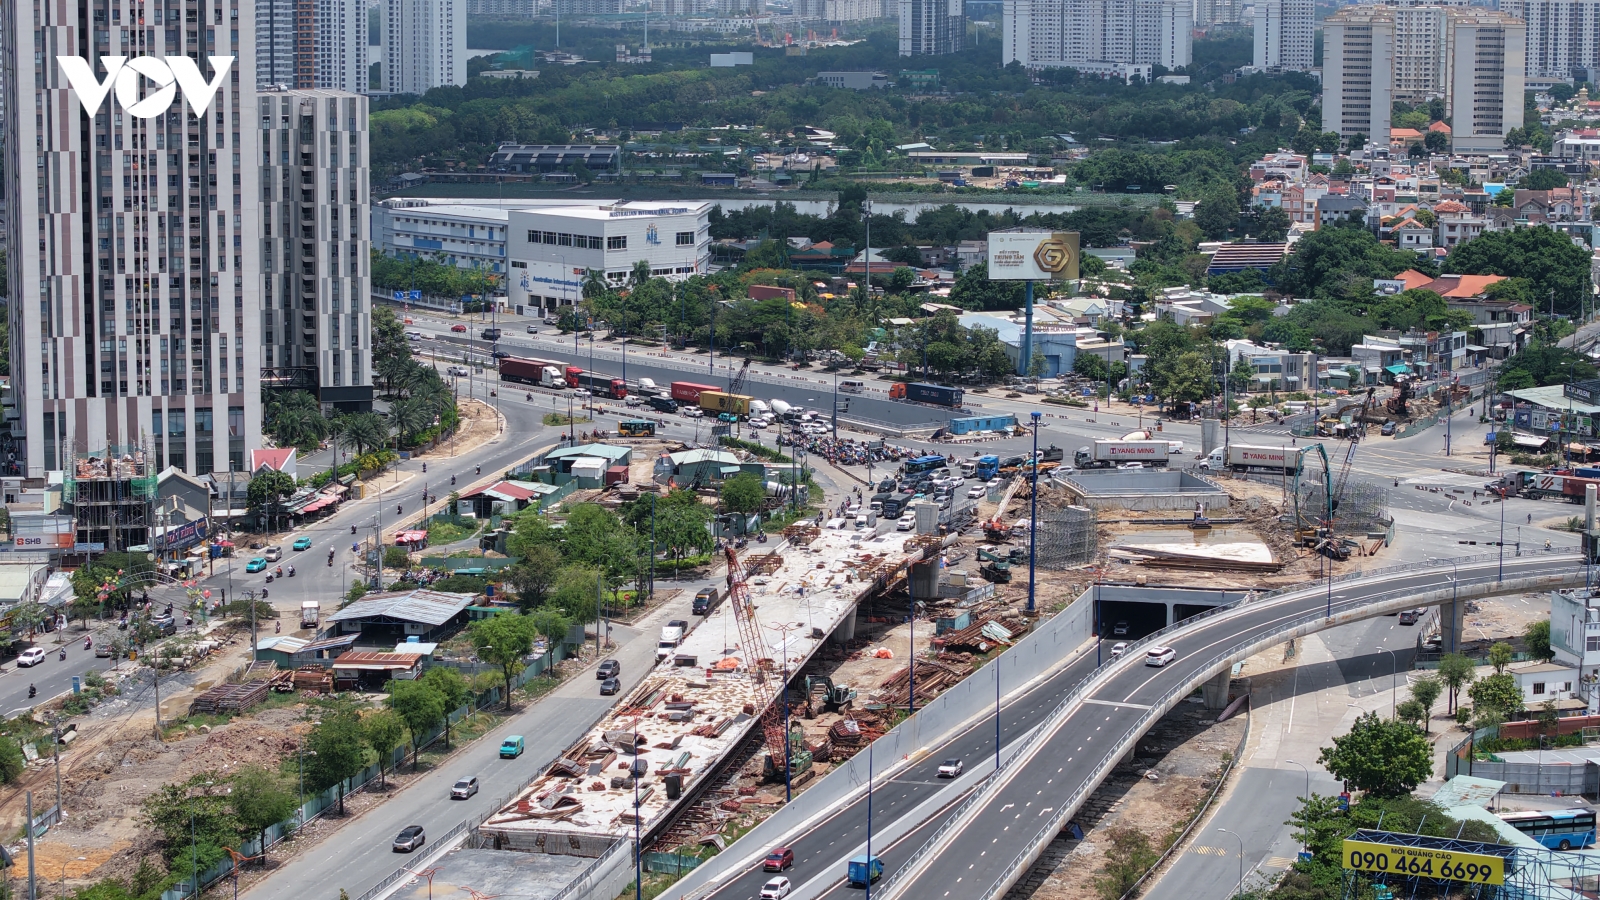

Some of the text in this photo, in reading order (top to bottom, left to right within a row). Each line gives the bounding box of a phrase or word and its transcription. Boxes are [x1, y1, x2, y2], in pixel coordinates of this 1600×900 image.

[533, 276, 552, 284] Australian
[1435, 852, 1452, 860] CÁO
[1350, 851, 1492, 881] 090 464 6699
